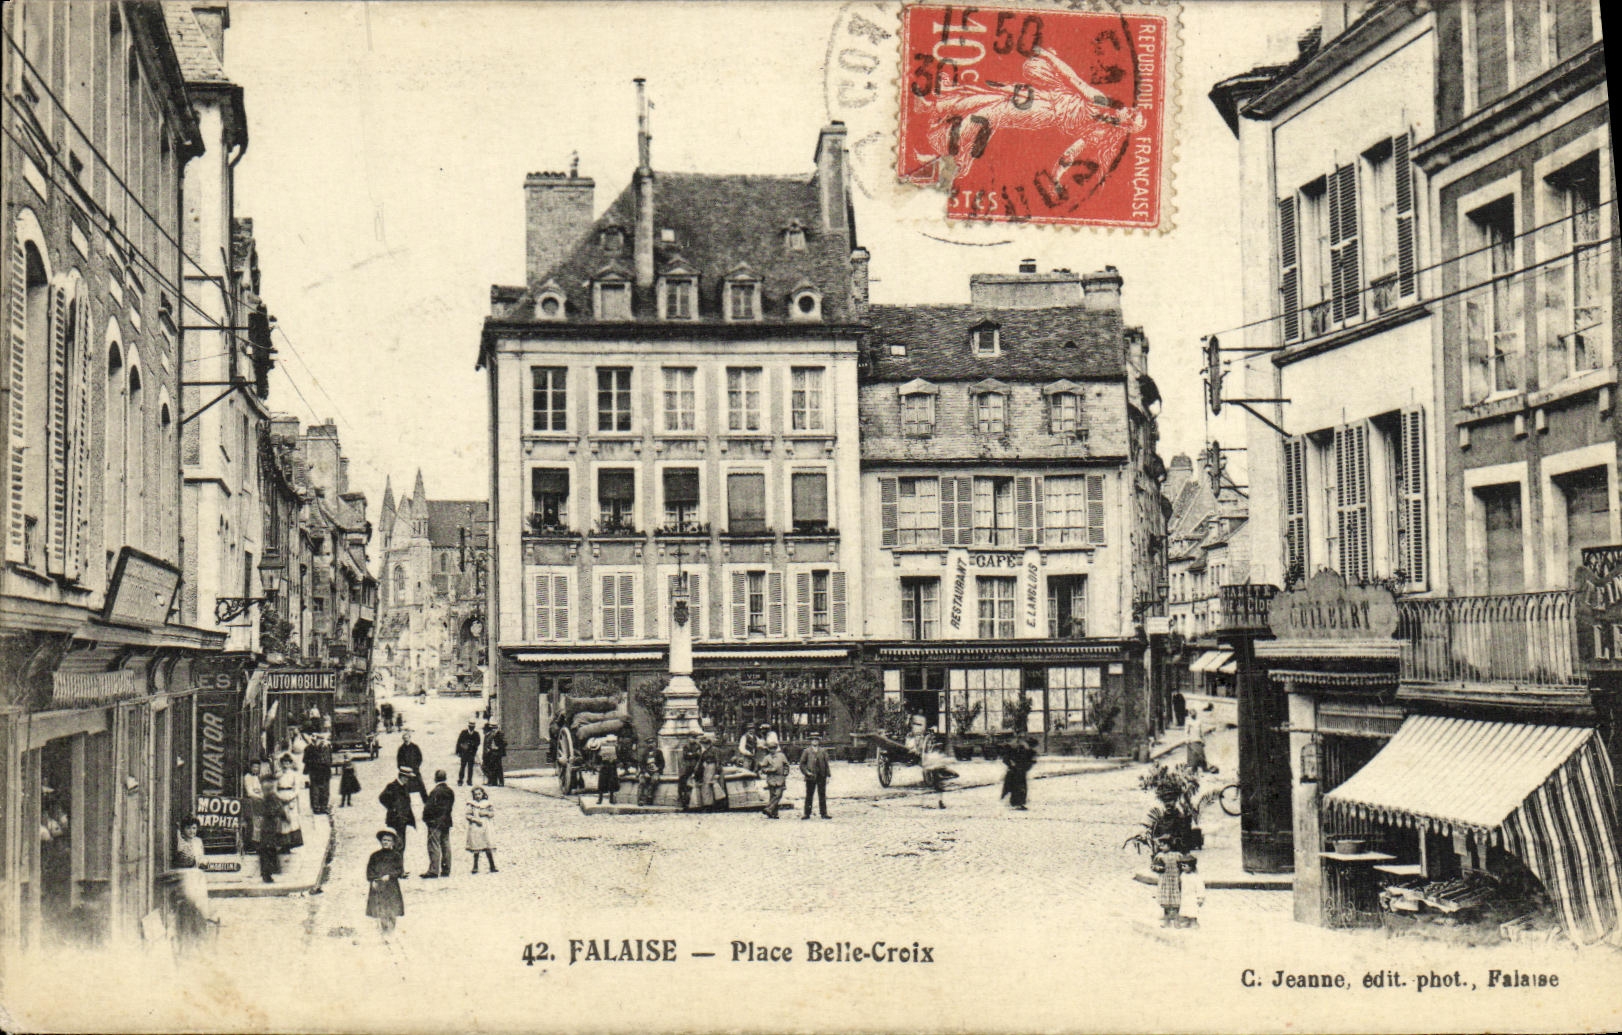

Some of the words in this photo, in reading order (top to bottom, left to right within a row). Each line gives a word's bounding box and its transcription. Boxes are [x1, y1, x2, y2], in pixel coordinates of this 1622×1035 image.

[932, 20, 987, 66] 10
[950, 557, 967, 630] RESTAURANT
[267, 672, 335, 690] AUTOMOBILINE
[197, 797, 241, 815] MOTO
